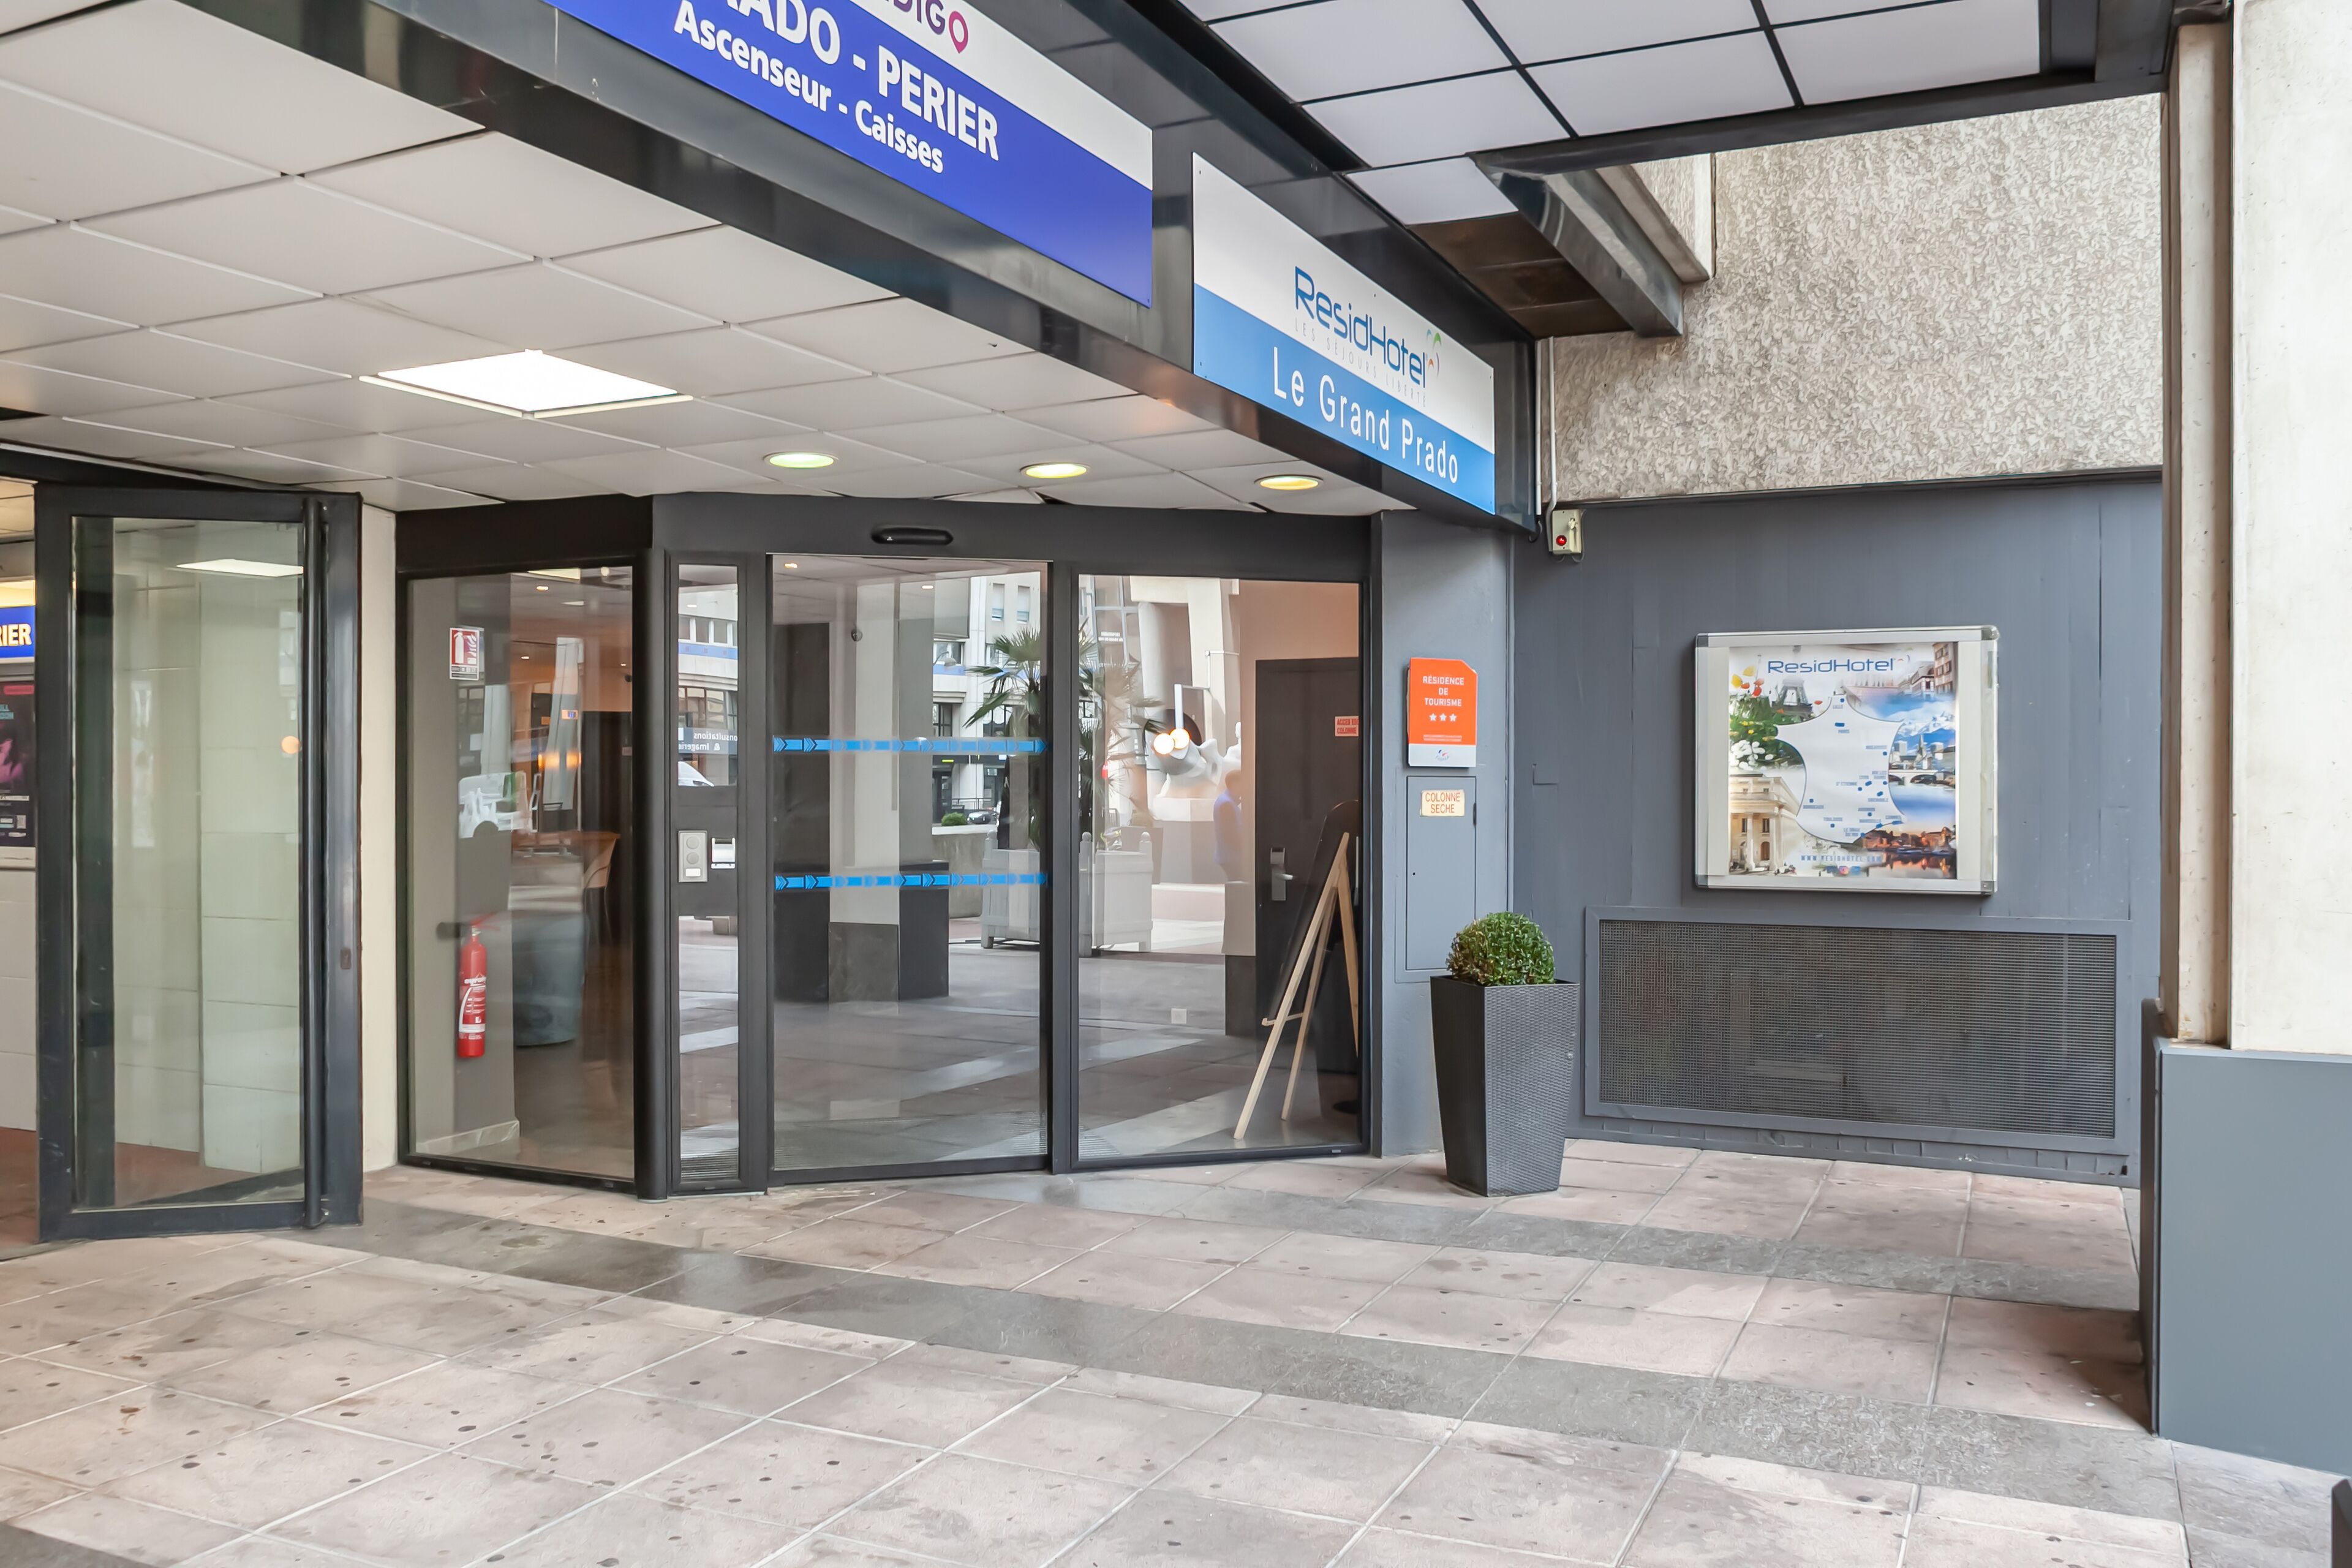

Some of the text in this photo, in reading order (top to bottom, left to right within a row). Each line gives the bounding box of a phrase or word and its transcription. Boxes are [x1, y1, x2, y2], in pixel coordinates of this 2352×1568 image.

[894, 0, 969, 54] IGO
[674, 0, 832, 112] Ascenseur
[855, 99, 944, 174] Caisses
[727, 0, 840, 65] ADO
[878, 45, 999, 161] PERIER
[1295, 266, 1425, 388] ResidHotel
[1295, 317, 1427, 408] LES SÉJOURS LIBERTÉ
[1273, 346, 1458, 484] Le Grand Prado
[0, 624, 32, 647] IER
[1767, 658, 1894, 674] ResidHotel
[1422, 674, 1464, 685] RÉSIDENCE
[1424, 697, 1462, 707] TOURISME
[1438, 687, 1449, 696] DE
[1425, 792, 1461, 802] COLONNE
[1430, 804, 1455, 814] SECHE
